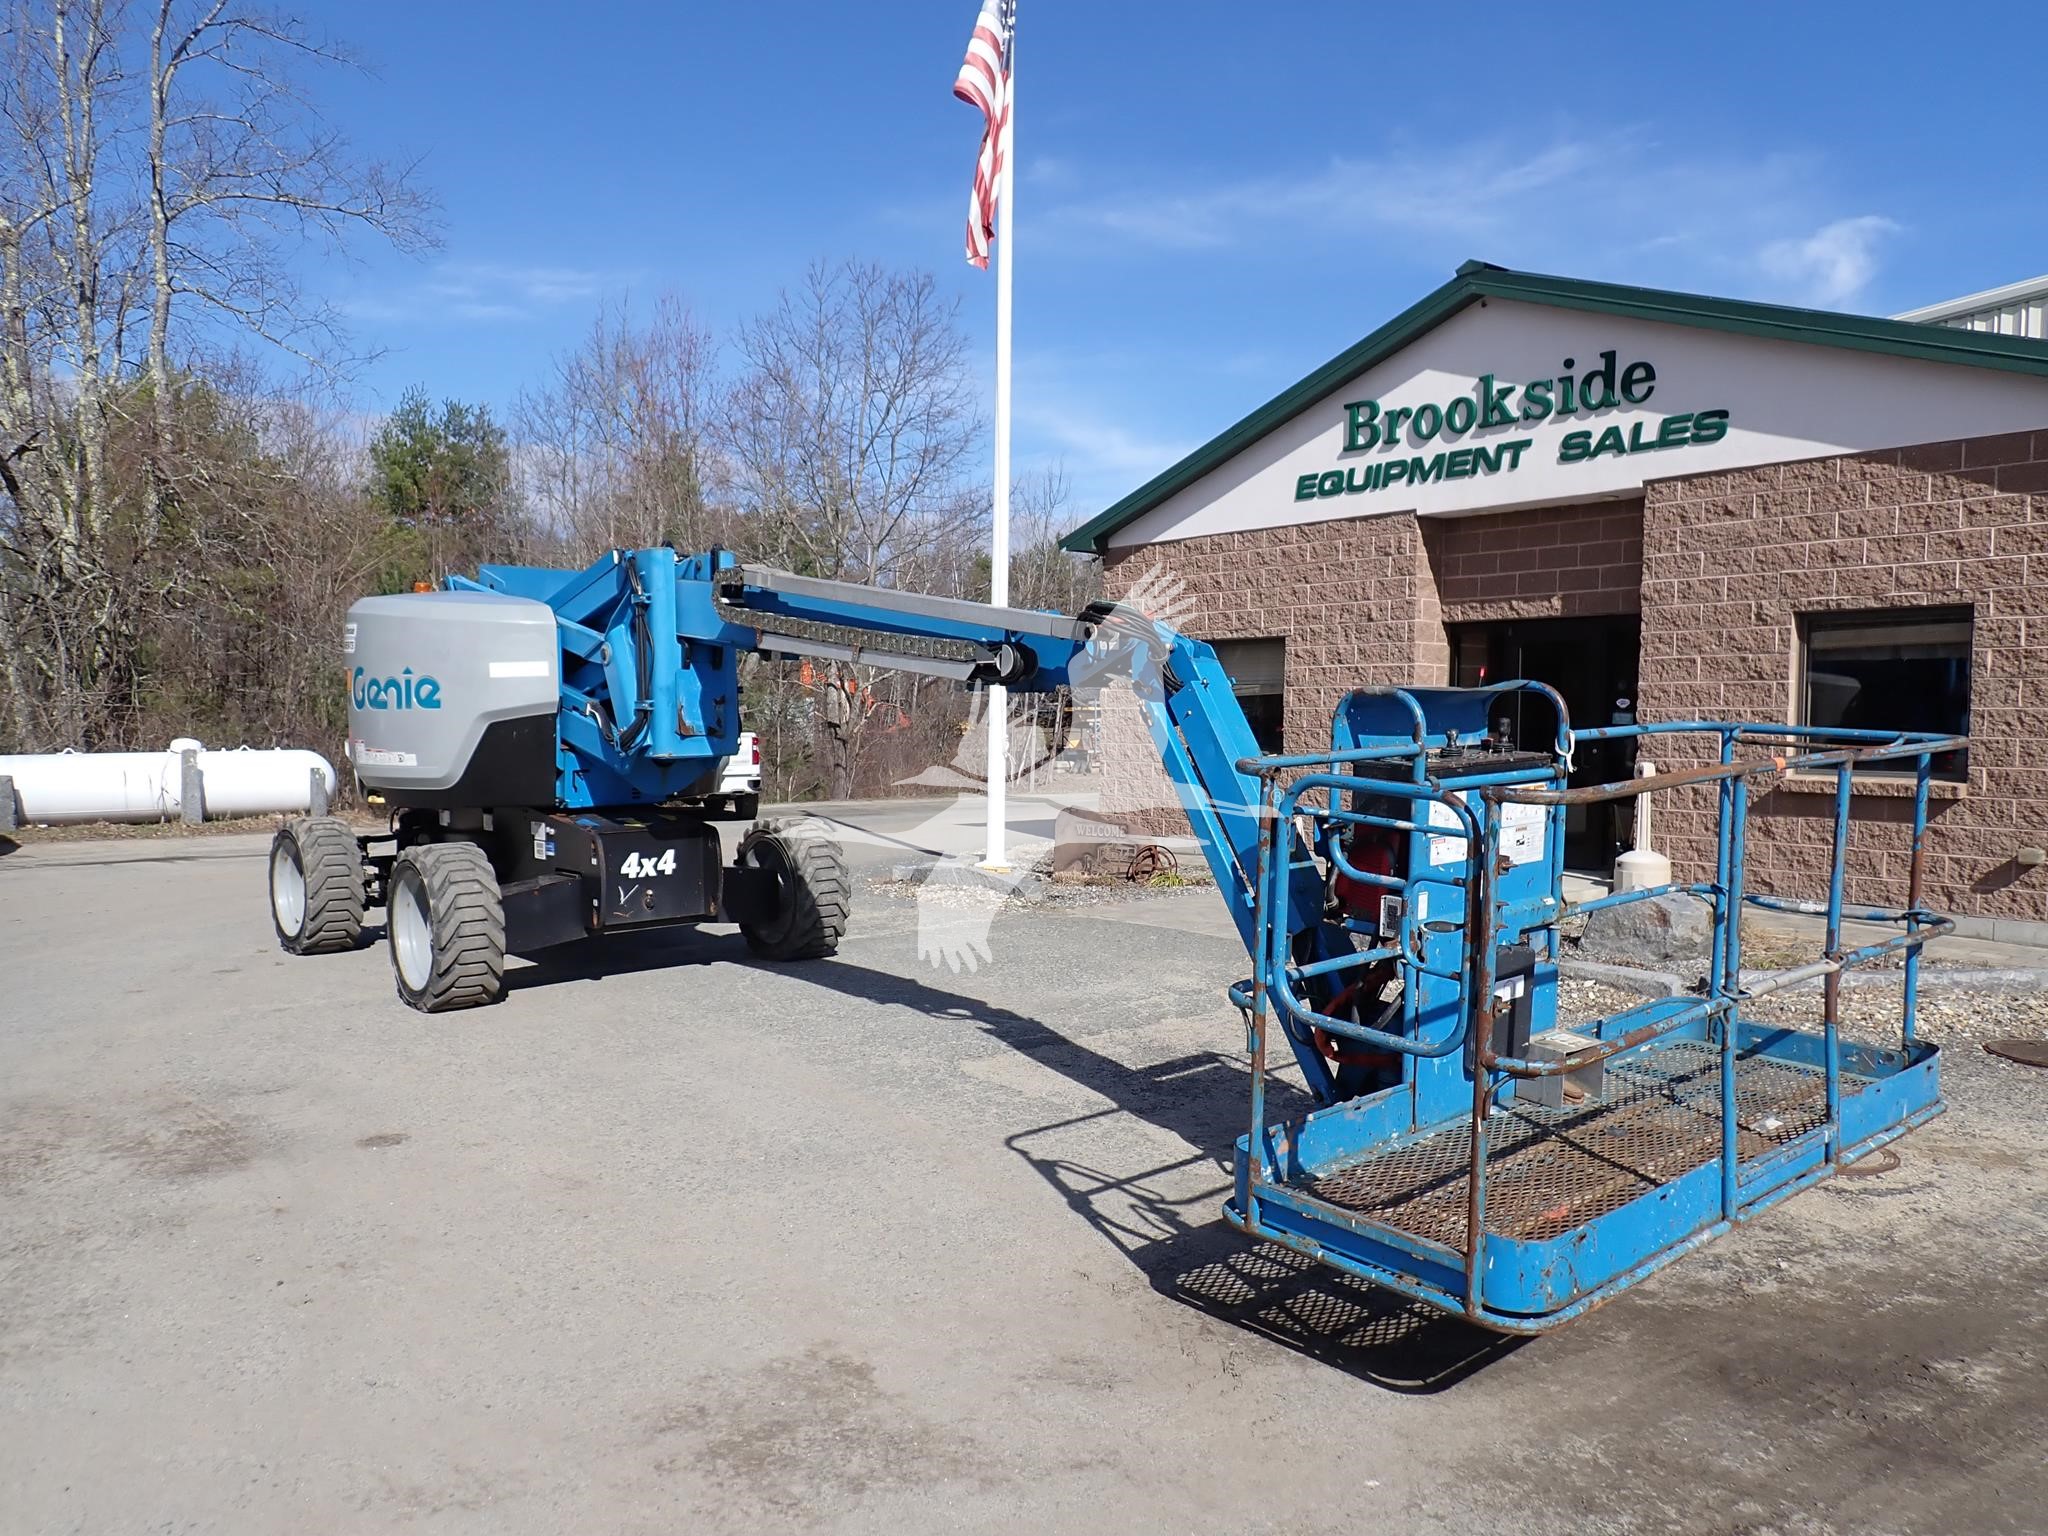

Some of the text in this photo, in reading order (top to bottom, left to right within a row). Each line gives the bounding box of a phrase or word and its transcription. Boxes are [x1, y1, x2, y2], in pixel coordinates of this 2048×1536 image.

[1343, 350, 1656, 452] Brookside
[1295, 409, 1729, 501] EQUIPMENT SALES
[353, 666, 440, 710] Genie
[1076, 823, 1127, 838] WELCOME
[620, 848, 677, 879] 4x4
